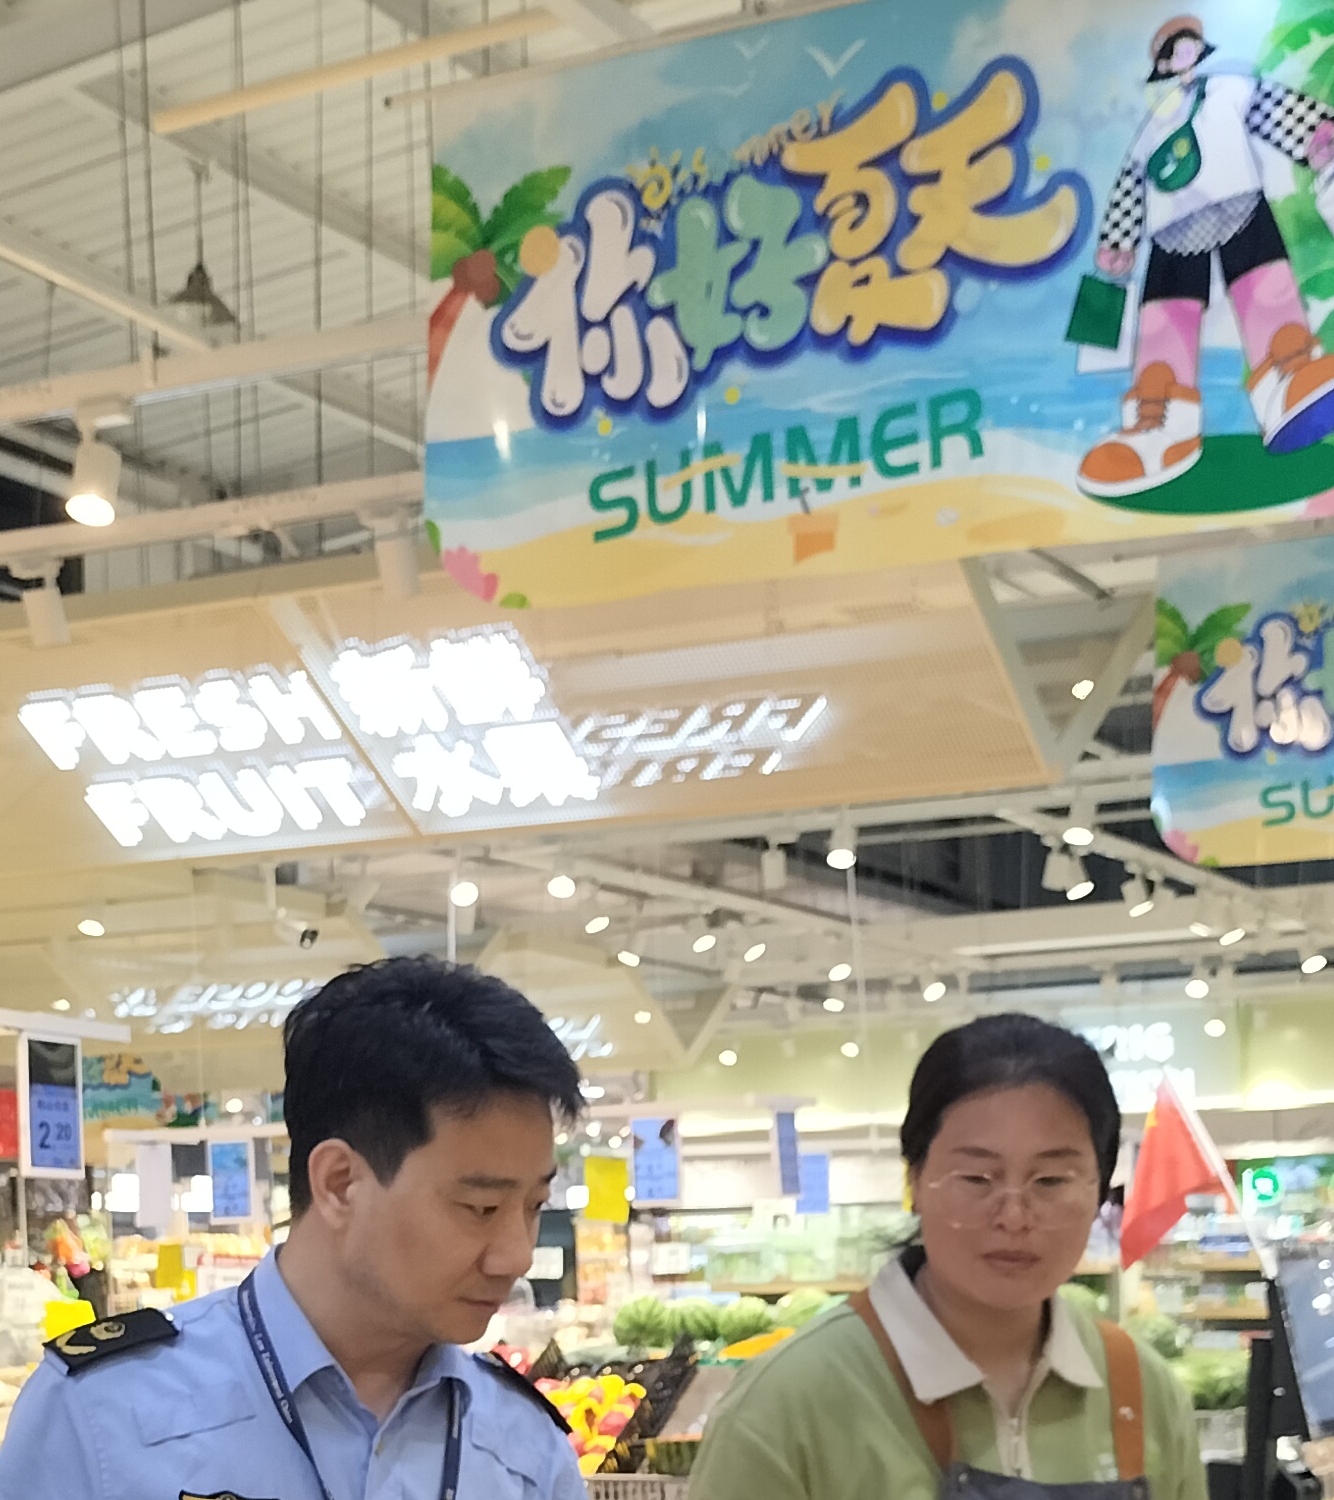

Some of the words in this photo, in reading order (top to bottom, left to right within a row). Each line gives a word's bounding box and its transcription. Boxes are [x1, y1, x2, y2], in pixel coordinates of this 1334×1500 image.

[499, 66, 1083, 420] 你好夏天
[589, 389, 987, 544] SUMMER
[18, 667, 343, 770] FRESH
[85, 755, 387, 847] FRUIT
